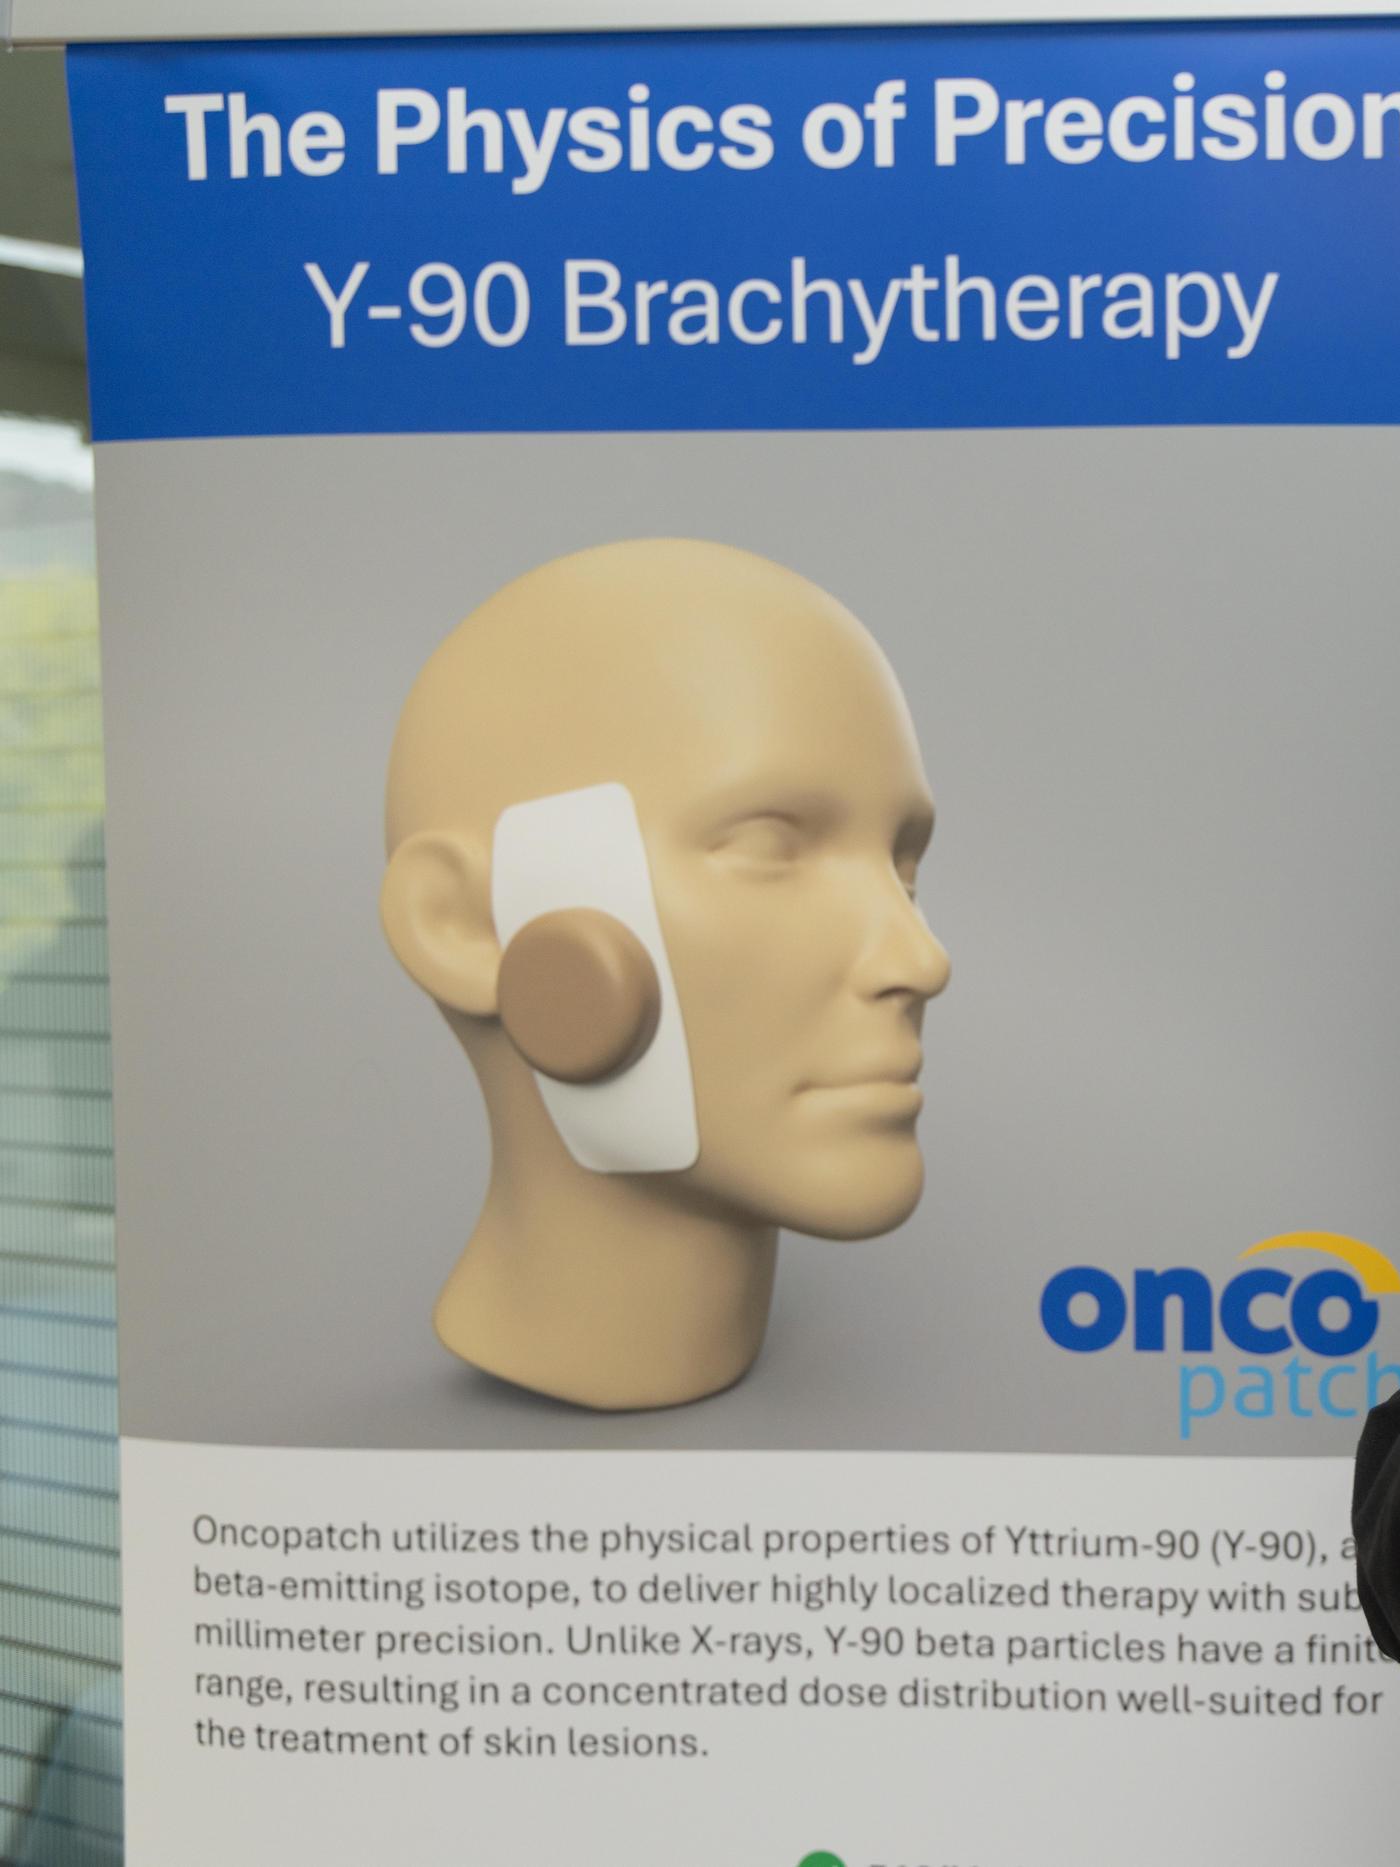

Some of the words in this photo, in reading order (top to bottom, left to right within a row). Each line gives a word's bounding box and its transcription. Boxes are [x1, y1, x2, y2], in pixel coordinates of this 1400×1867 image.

[164, 92, 346, 181] The
[376, 83, 775, 195] Physics
[802, 79, 907, 169] of
[304, 261, 531, 348] Y-90
[564, 254, 1279, 365] Brachytherapy
[1039, 1265, 1380, 1358] onco
[193, 1514, 381, 1556] Oncopatch
[392, 1522, 520, 1553] utilizes
[530, 1523, 589, 1553] the
[600, 1522, 753, 1560] physical
[763, 1524, 950, 1560] properties
[961, 1525, 996, 1555] of
[1005, 1525, 1200, 1560] Yttrium-90
[1211, 1529, 1328, 1567] (Y-90),
[194, 1565, 425, 1611] beta-emitting
[435, 1573, 580, 1610] isotope,
[591, 1576, 627, 1604] to
[638, 1573, 761, 1604] deliver
[771, 1573, 878, 1612] highly
[888, 1574, 1049, 1608] localized
[1060, 1579, 1199, 1618] therapy
[1207, 1580, 1286, 1612] with
[195, 1618, 366, 1653] millimeter
[376, 1624, 554, 1661] precision.
[567, 1624, 680, 1656] Unlike
[691, 1625, 813, 1663] X-rays,
[824, 1625, 904, 1657] Y-90
[915, 1627, 995, 1658] beta
[1007, 1630, 1166, 1666] particles
[1178, 1633, 1263, 1665] have
[1274, 1641, 1294, 1665] a
[195, 1669, 293, 1707] range,
[304, 1674, 459, 1713] resulting
[469, 1675, 499, 1705] in
[511, 1682, 531, 1706] a
[542, 1676, 787, 1706] concentrated
[799, 1676, 888, 1707] dose
[898, 1677, 1106, 1712] distribution
[1117, 1682, 1322, 1716] well-suited
[1333, 1684, 1384, 1715] for
[195, 1718, 246, 1749] the
[254, 1724, 428, 1756] treatment
[438, 1726, 474, 1757] of
[484, 1726, 556, 1757] skin
[568, 1726, 708, 1757] lesions.
